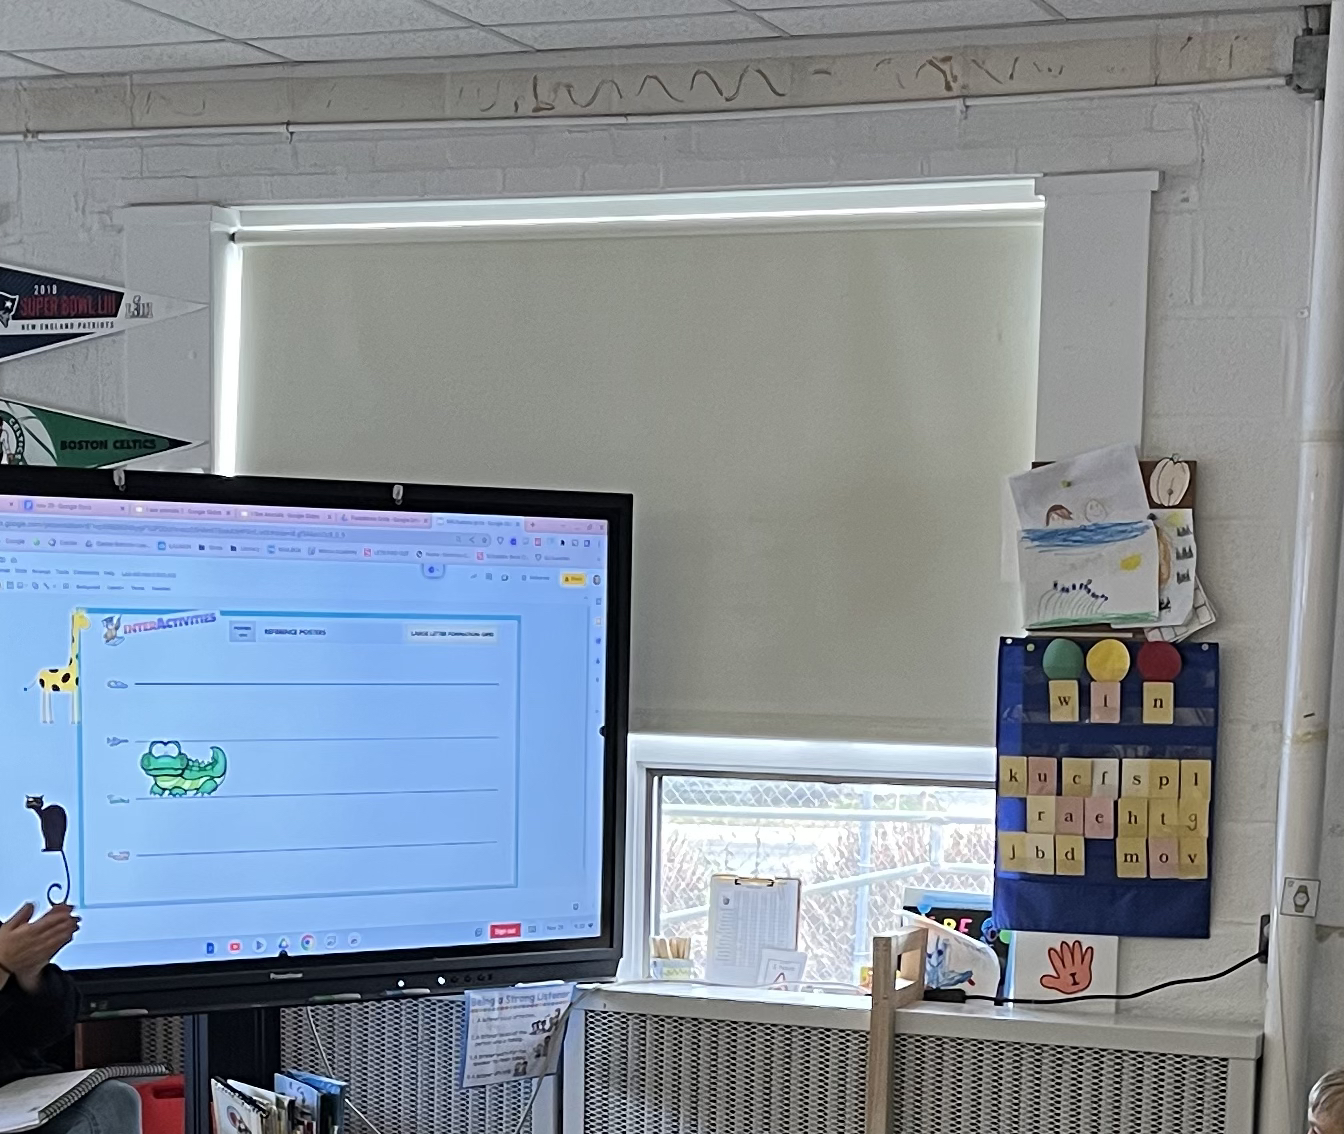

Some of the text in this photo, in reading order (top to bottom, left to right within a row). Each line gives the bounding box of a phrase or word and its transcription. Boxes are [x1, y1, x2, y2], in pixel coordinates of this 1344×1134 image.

[34, 284, 57, 295] 2018
[19, 296, 58, 317] SUPER
[61, 295, 96, 316] BOWL
[21, 321, 115, 331] NEW ENGLAND PATRIOTS
[8, 418, 24, 460] CELTICS
[60, 438, 156, 451] BOSTON CELTICS
[1058, 695, 1164, 709] w n
[1009, 768, 1019, 783] k
[1037, 773, 1048, 783] u
[1072, 774, 1082, 785] c
[1100, 771, 1109, 786] f
[1132, 774, 1142, 786] s
[1158, 775, 1170, 790] p
[1037, 810, 1199, 830] r a e h t g
[1010, 844, 1198, 864] j b d m o v
[1069, 971, 1080, 986] I
[471, 990, 571, 1007] Being a Strong Listener
